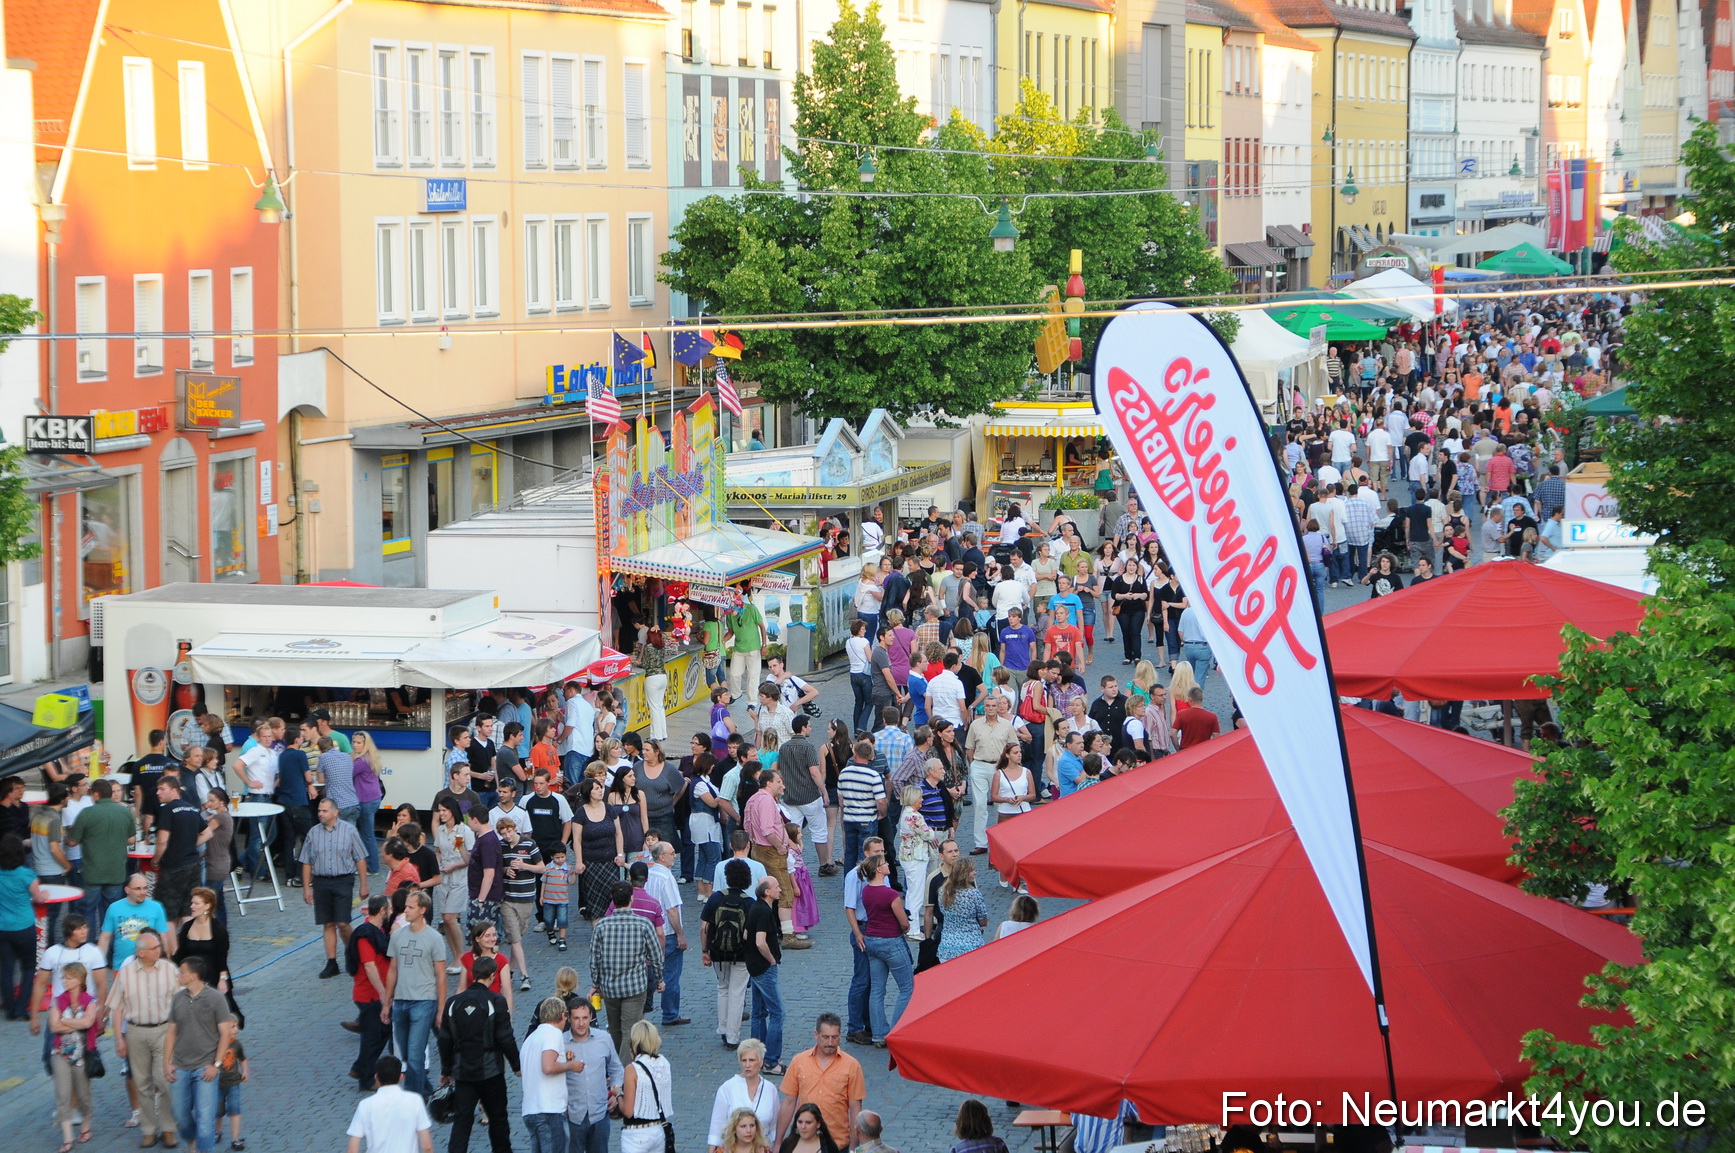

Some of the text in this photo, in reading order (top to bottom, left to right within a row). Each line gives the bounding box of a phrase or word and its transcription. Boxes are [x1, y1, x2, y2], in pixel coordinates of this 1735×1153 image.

[196, 400, 215, 409] DER
[27, 417, 89, 439] KBK
[726, 491, 767, 502] ykonos
[836, 493, 847, 501] 29
[762, 580, 791, 591] AUSWAHL
[700, 594, 730, 606] AUSWAHL
